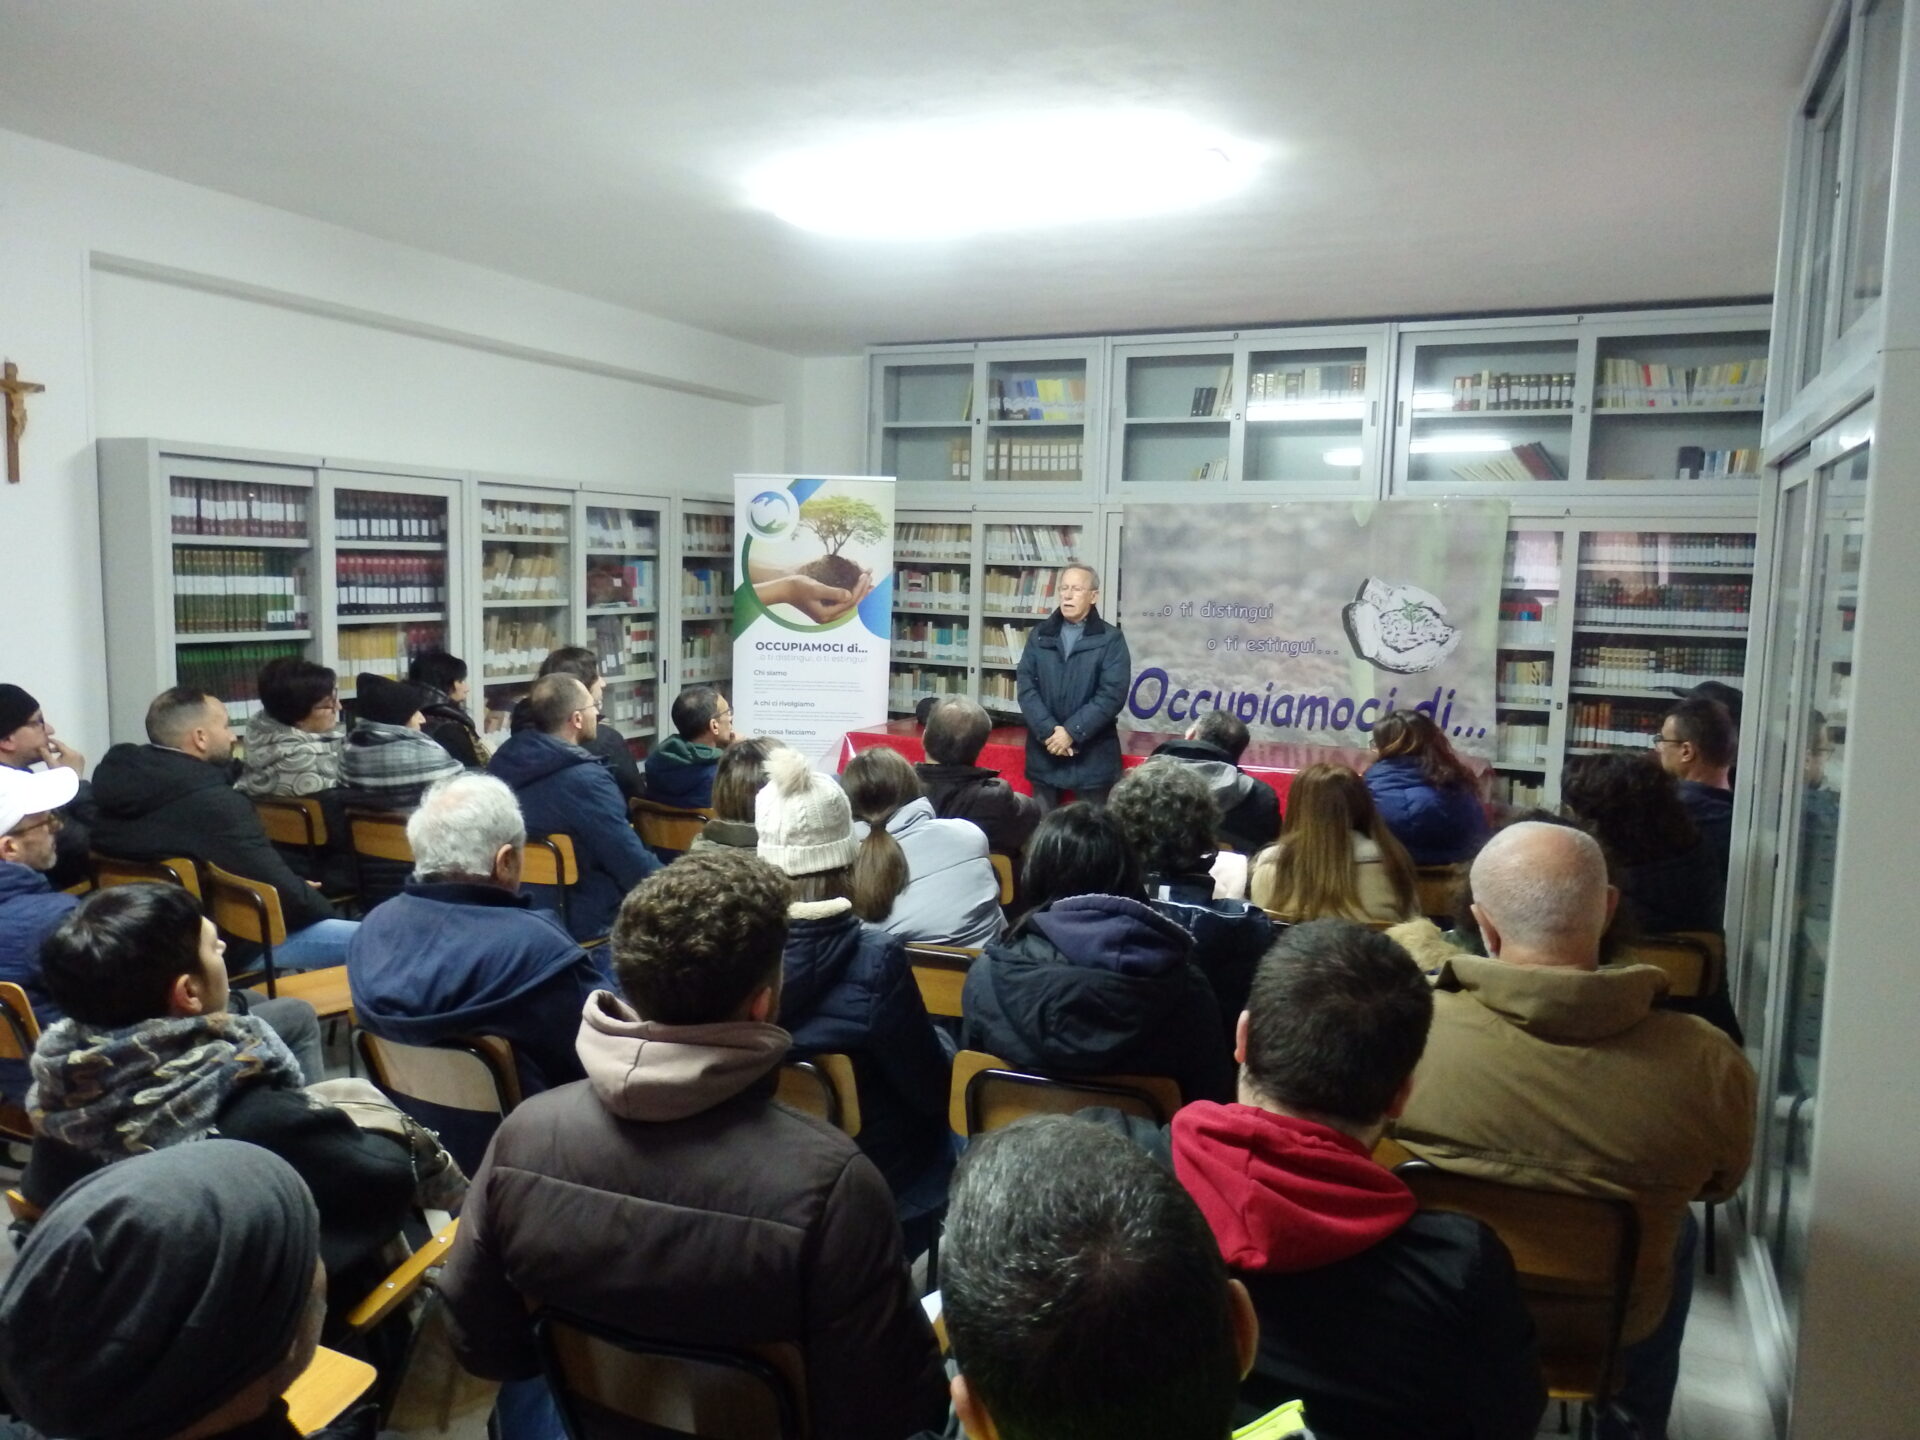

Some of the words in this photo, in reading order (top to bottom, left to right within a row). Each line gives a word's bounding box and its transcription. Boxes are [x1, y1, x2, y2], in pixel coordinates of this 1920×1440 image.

[1180, 602, 1193, 617] ti
[1200, 602, 1274, 623] distingui
[755, 641, 844, 653] OCCUPIAMOCI
[847, 642, 868, 653] di...
[1207, 638, 1216, 650] o
[1225, 636, 1239, 651] ti
[766, 669, 788, 677] siamo
[779, 700, 815, 708] rivolgiamo
[1415, 685, 1487, 739] di...
[785, 728, 816, 736] facciamo
